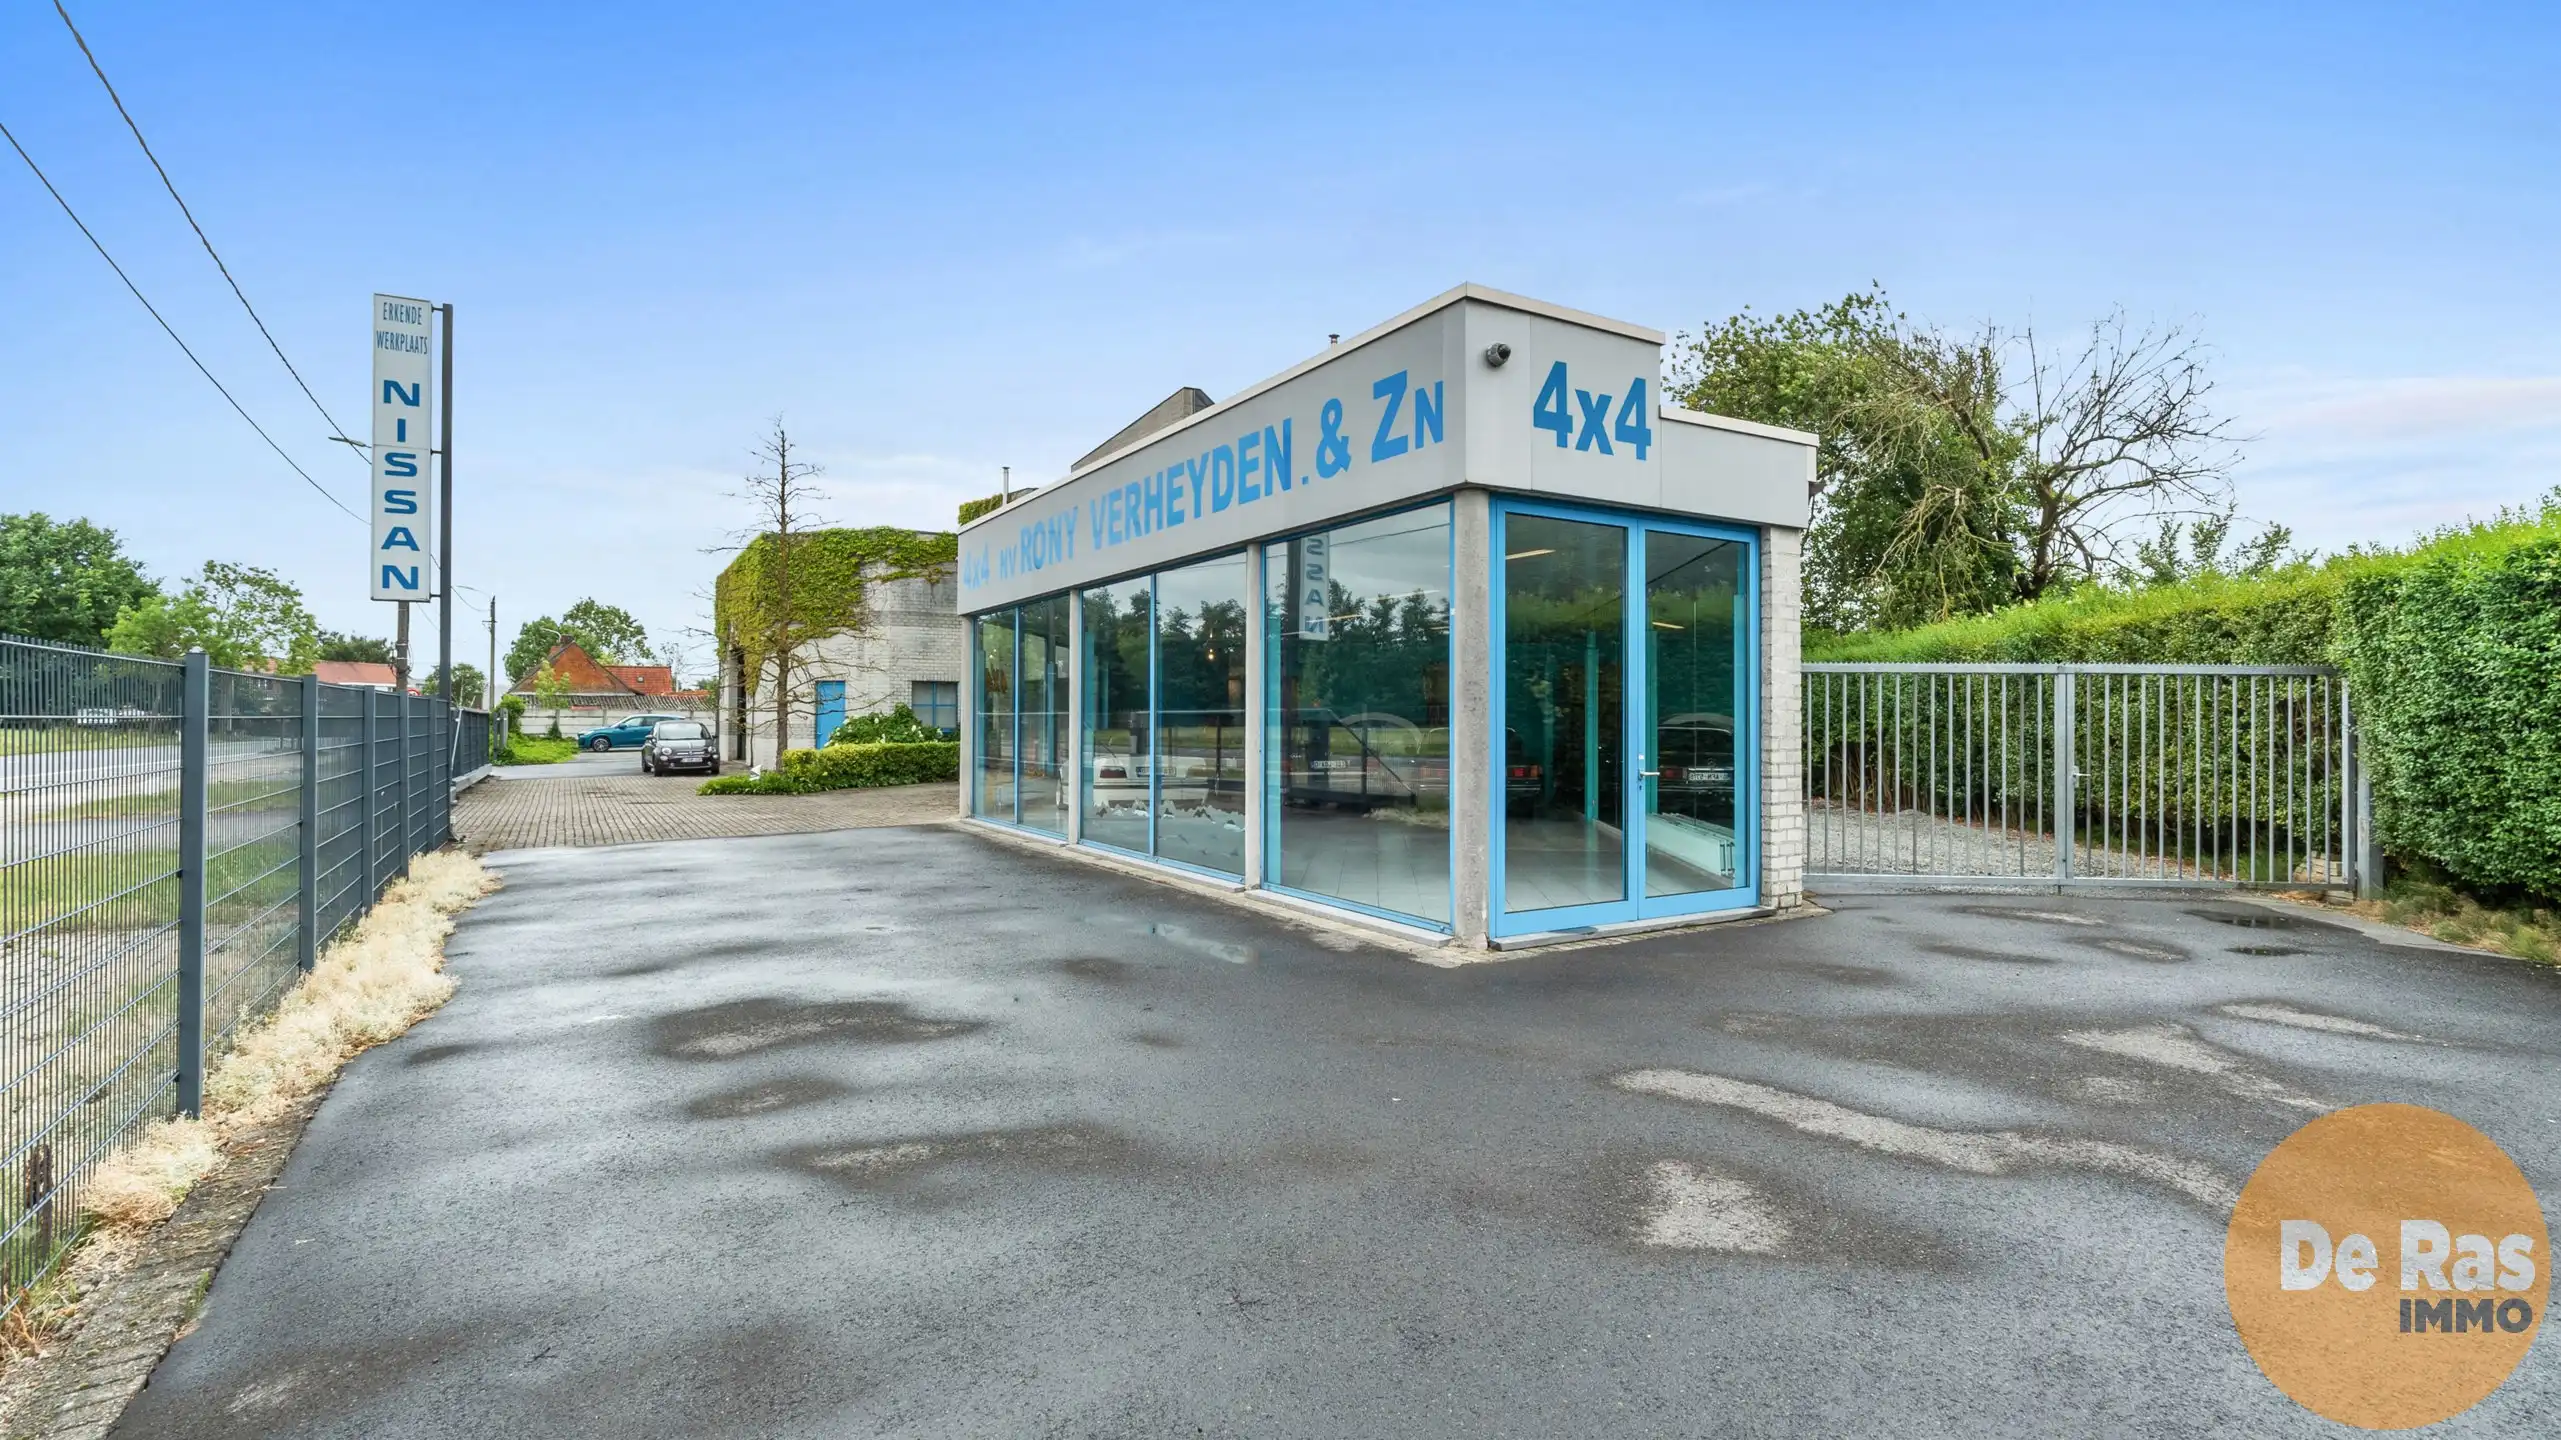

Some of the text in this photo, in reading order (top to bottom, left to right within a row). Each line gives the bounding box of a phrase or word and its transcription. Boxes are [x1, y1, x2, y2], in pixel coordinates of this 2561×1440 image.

[376, 330, 428, 355] WERKPLAATS
[383, 302, 422, 325] ERKENDE
[1533, 361, 1652, 461] 4x4
[381, 380, 420, 590] NISSAN
[1021, 505, 1078, 574] RONY
[1316, 398, 1352, 479] &
